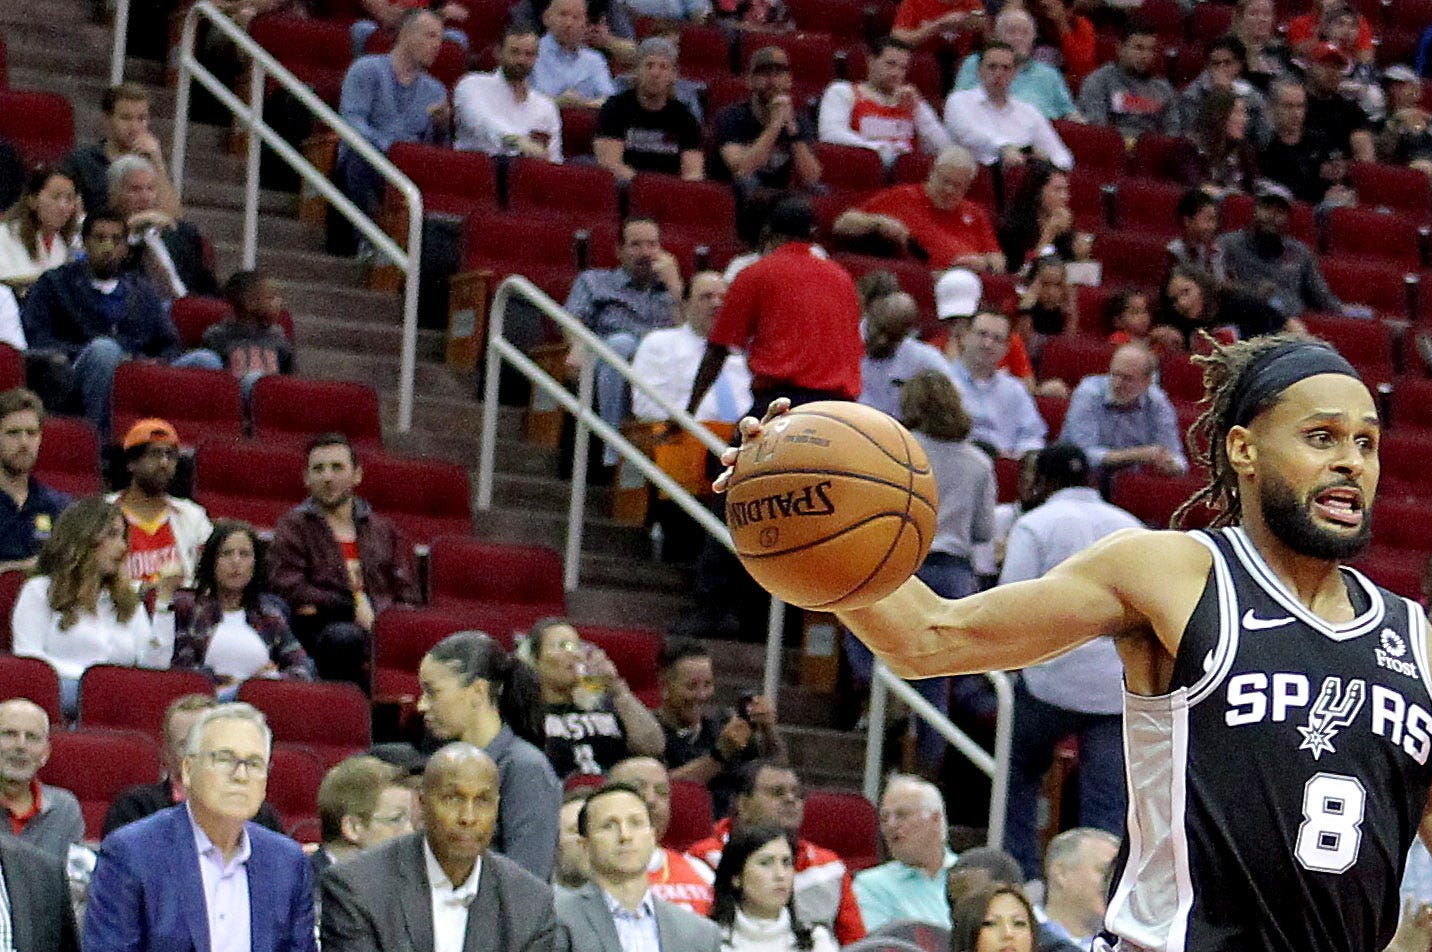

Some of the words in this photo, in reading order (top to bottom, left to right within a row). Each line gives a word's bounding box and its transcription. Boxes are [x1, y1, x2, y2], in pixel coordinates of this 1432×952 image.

[731, 481, 835, 529] SPALDIN
[1375, 648, 1419, 679] Frost
[1294, 772, 1367, 875] 8
